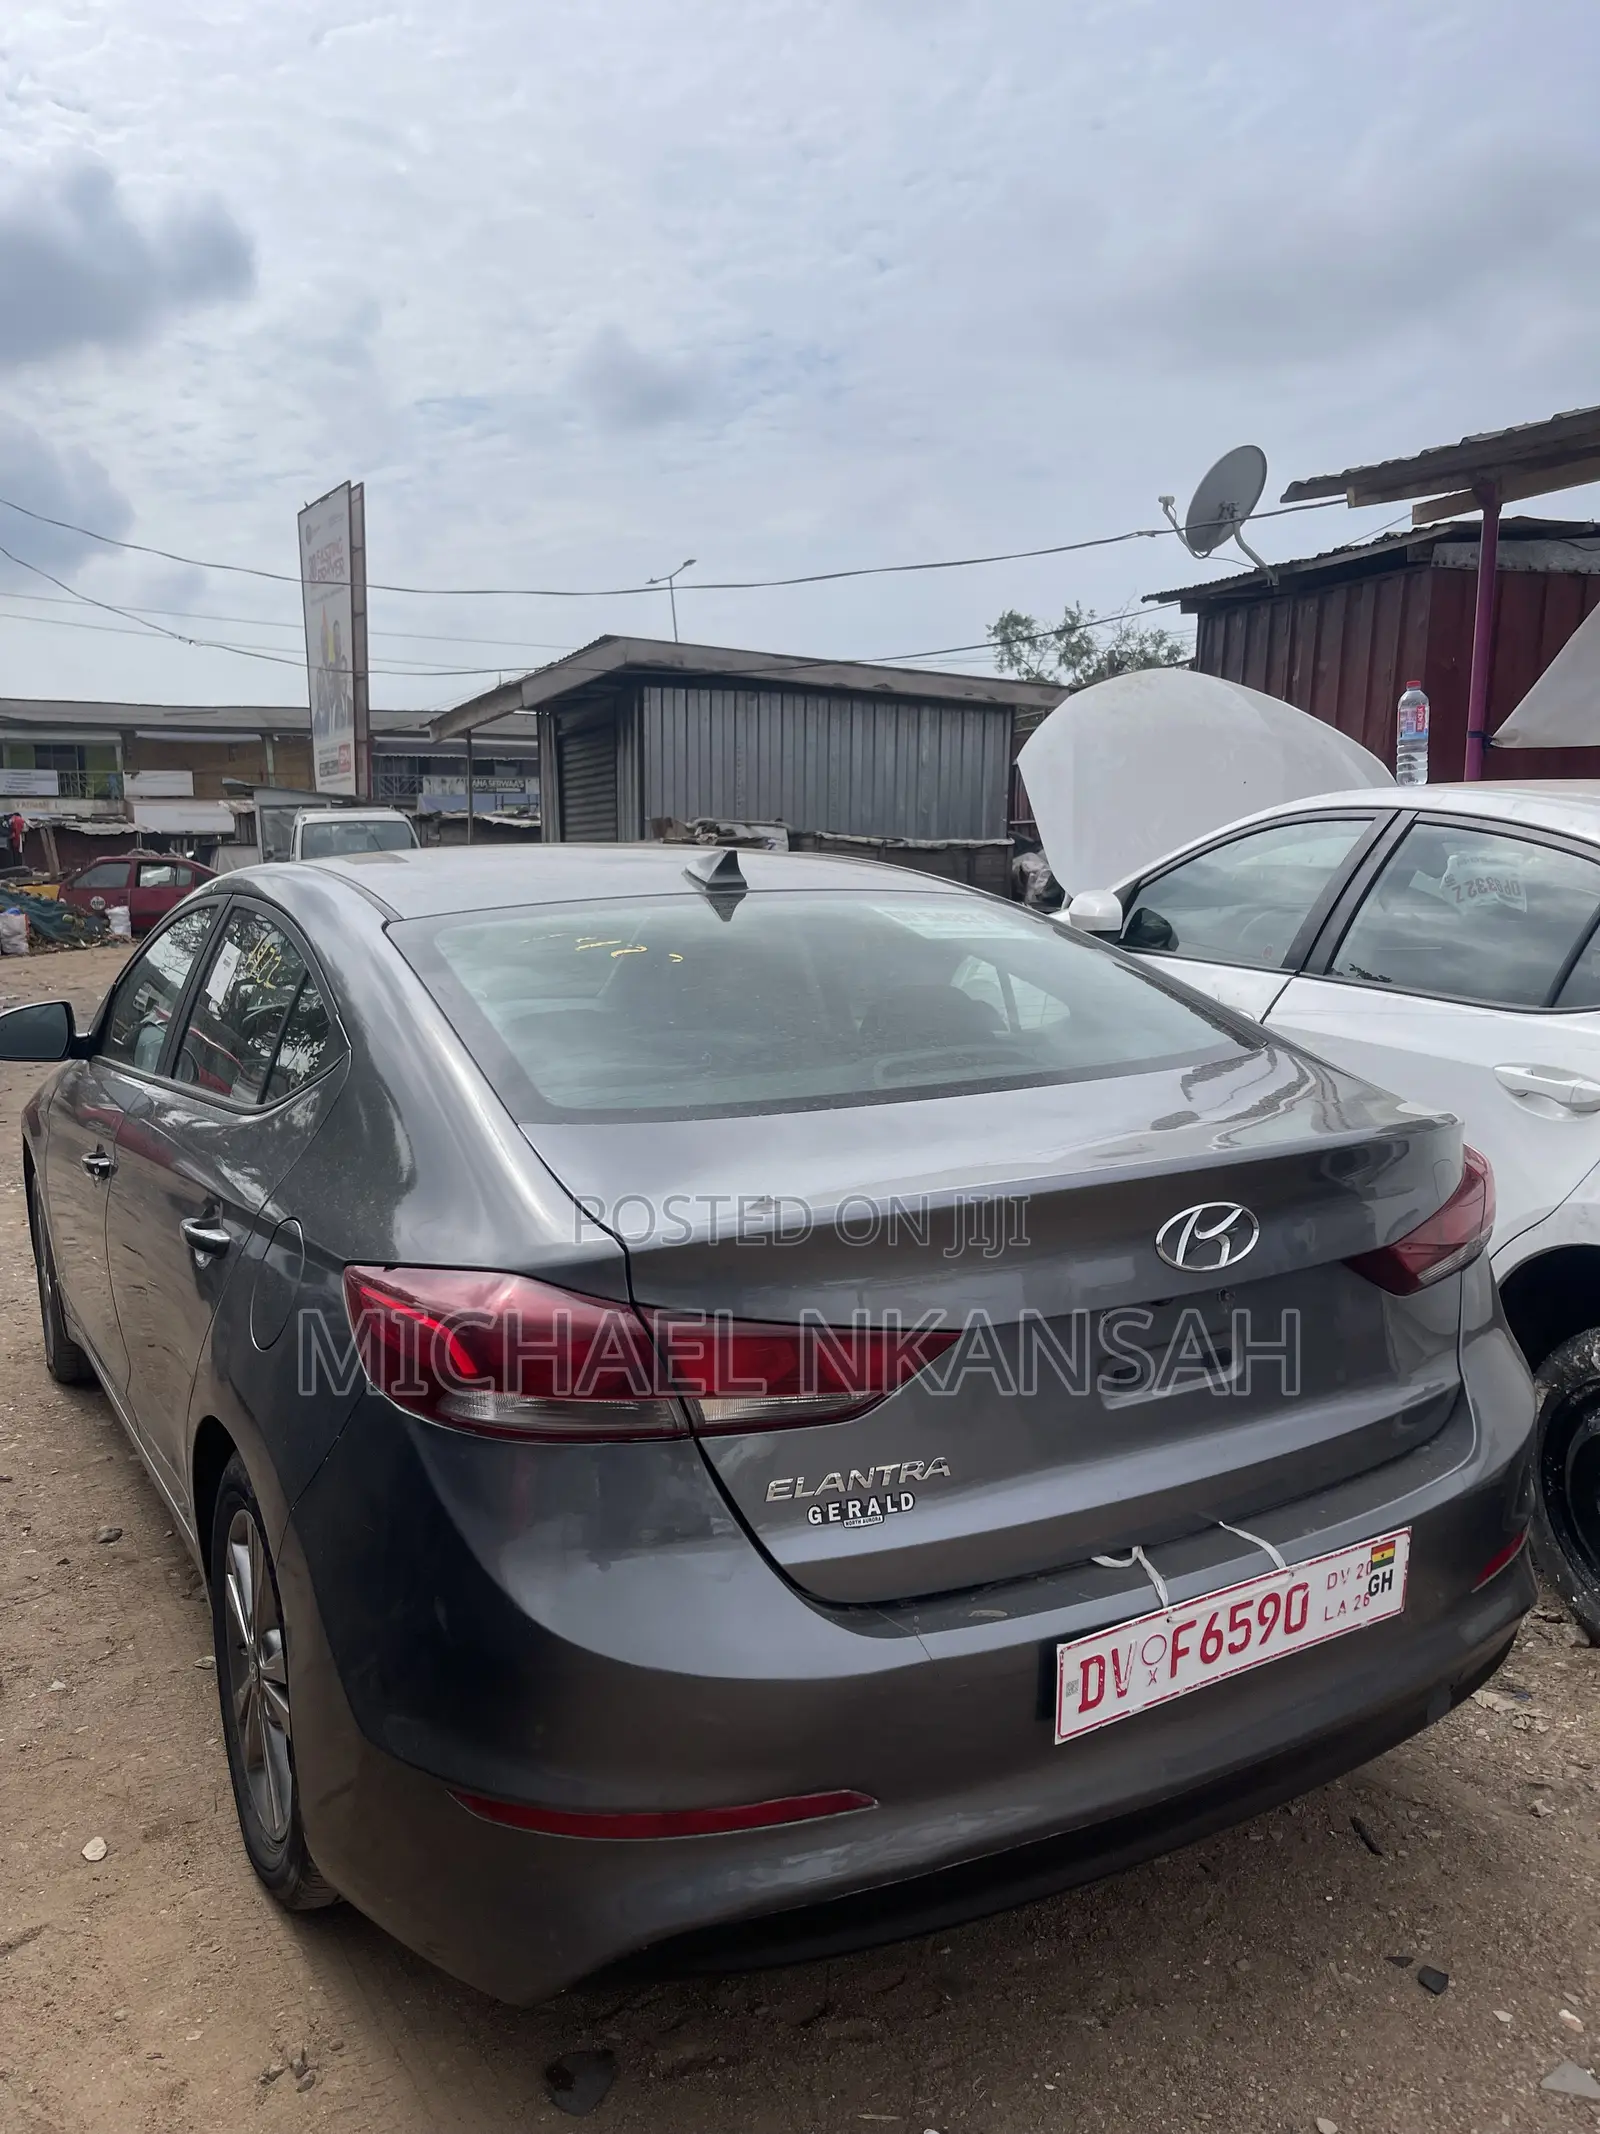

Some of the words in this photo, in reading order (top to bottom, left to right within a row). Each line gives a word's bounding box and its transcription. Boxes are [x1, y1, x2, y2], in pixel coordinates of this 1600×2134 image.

[765, 1456, 951, 1502] ELANTRA
[807, 1492, 915, 1525] GERALD
[862, 1516, 881, 1524] AURORA
[1326, 1566, 1351, 1591] DV
[1368, 1568, 1394, 1598] GH
[1323, 1599, 1347, 1622] LA
[1353, 1591, 1371, 1612] 26
[1078, 1640, 1138, 1714] DV
[1169, 1581, 1310, 1679] F6590
